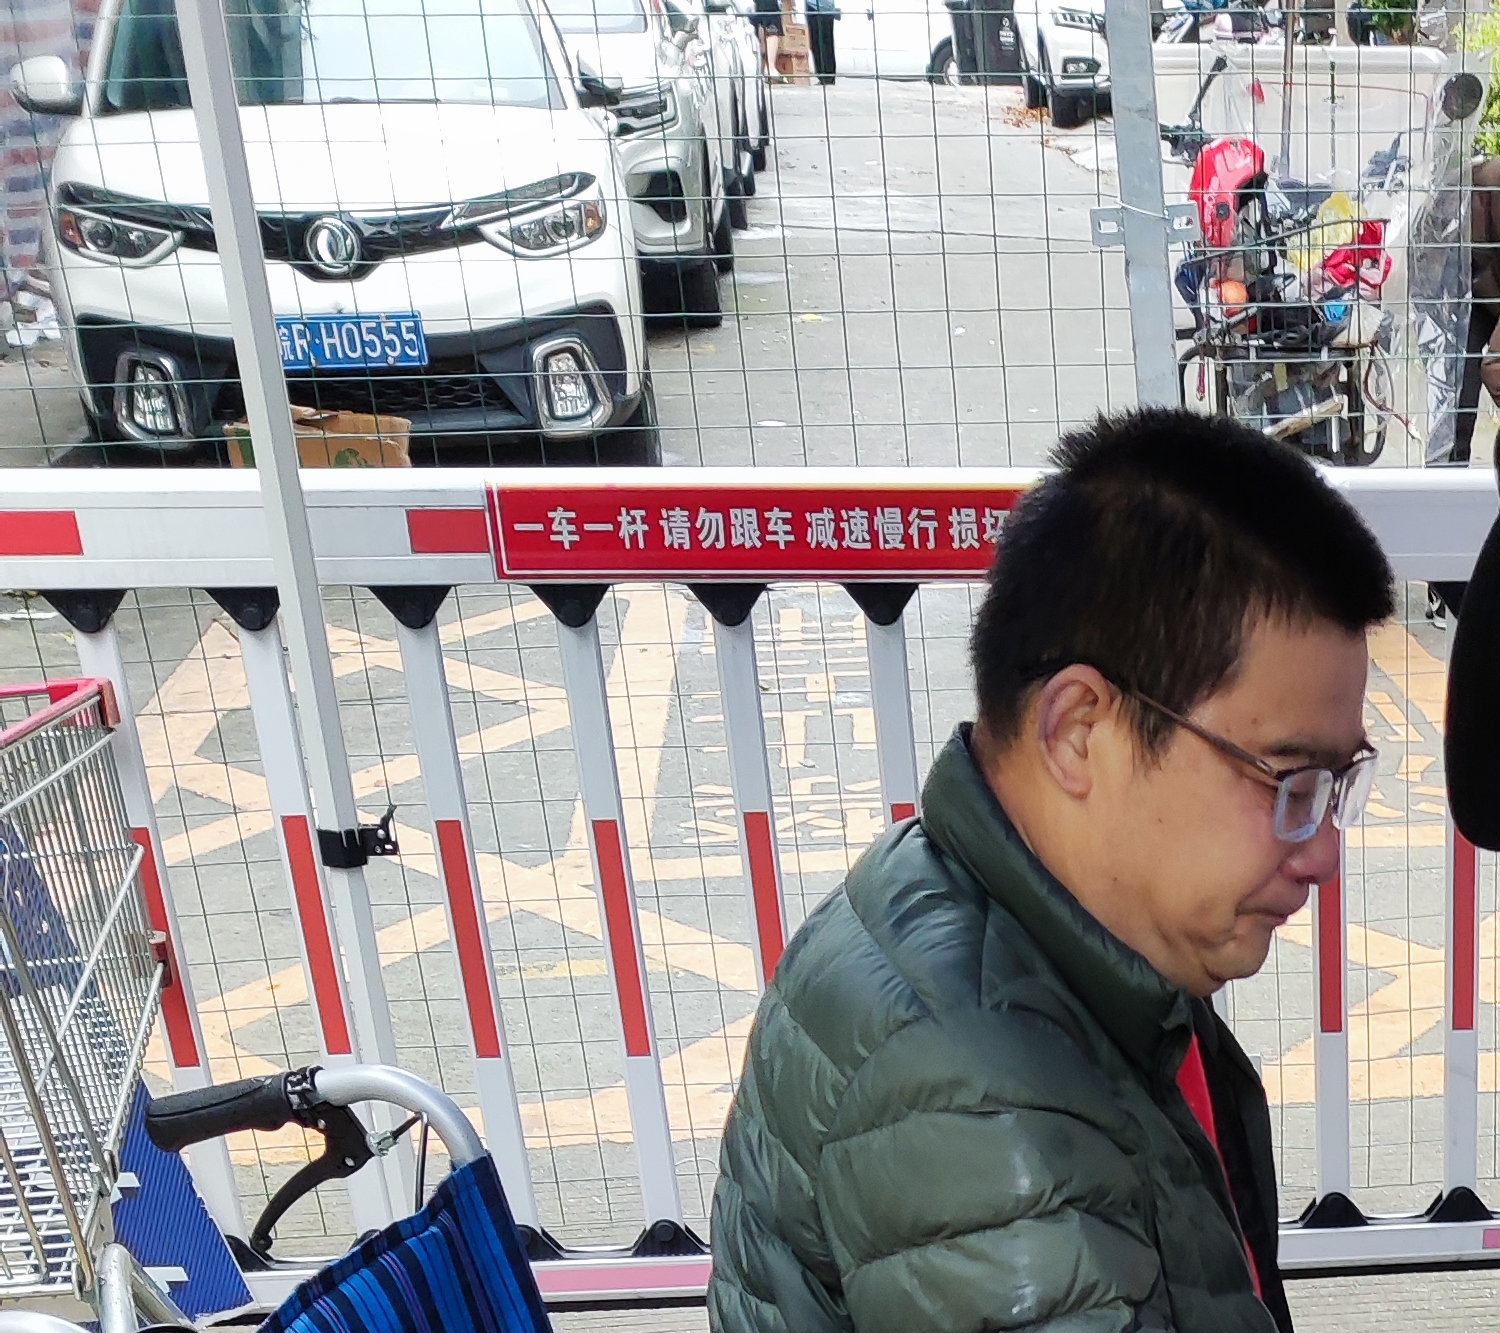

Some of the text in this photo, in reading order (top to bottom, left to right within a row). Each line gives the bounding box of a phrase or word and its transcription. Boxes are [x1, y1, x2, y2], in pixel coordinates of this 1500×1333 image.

[513, 506, 648, 549] 一车一杆
[659, 506, 796, 549] 请勿跟车
[806, 507, 939, 549] 减速慢行
